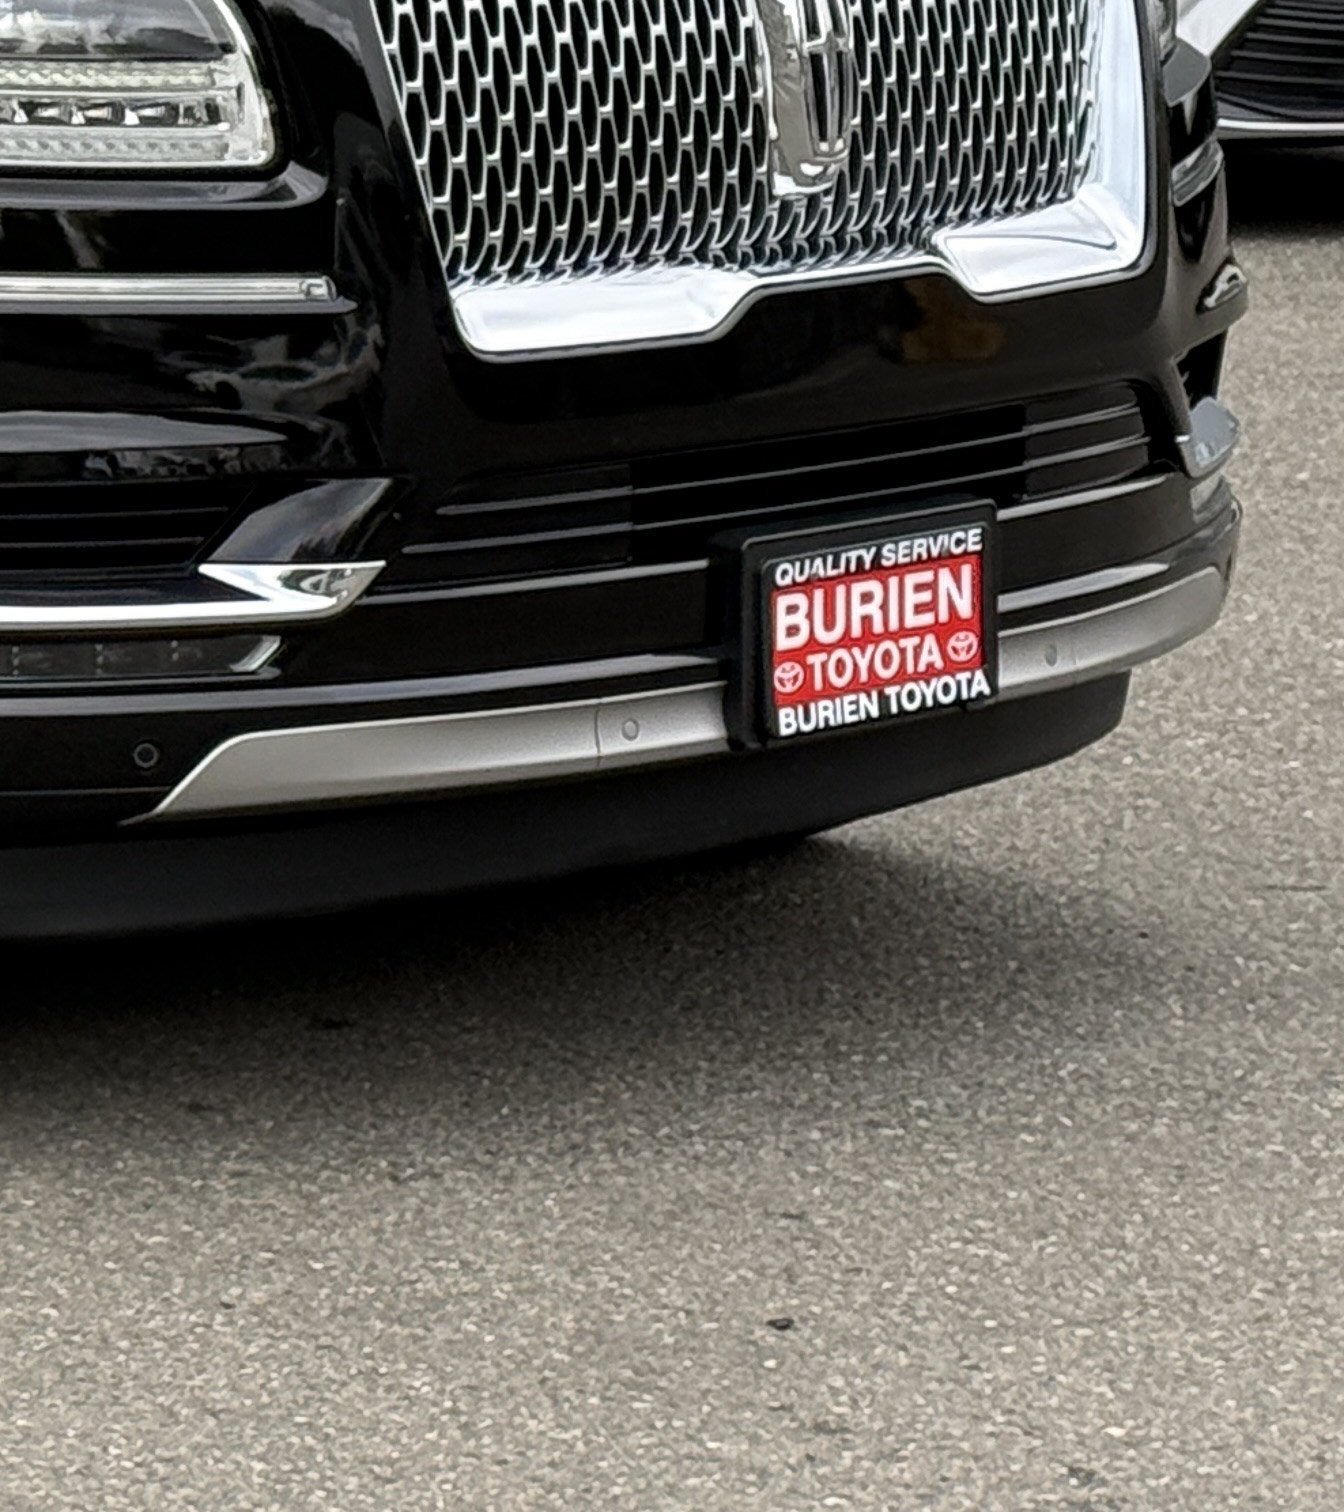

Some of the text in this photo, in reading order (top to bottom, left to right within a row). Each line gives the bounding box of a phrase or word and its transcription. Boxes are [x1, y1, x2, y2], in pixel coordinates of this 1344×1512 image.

[774, 527, 983, 587] QUALITY SERVICE
[775, 563, 974, 652] BURIEN
[806, 633, 945, 692] TOYOTA
[778, 669, 992, 737] BURIEN TOYOTA
